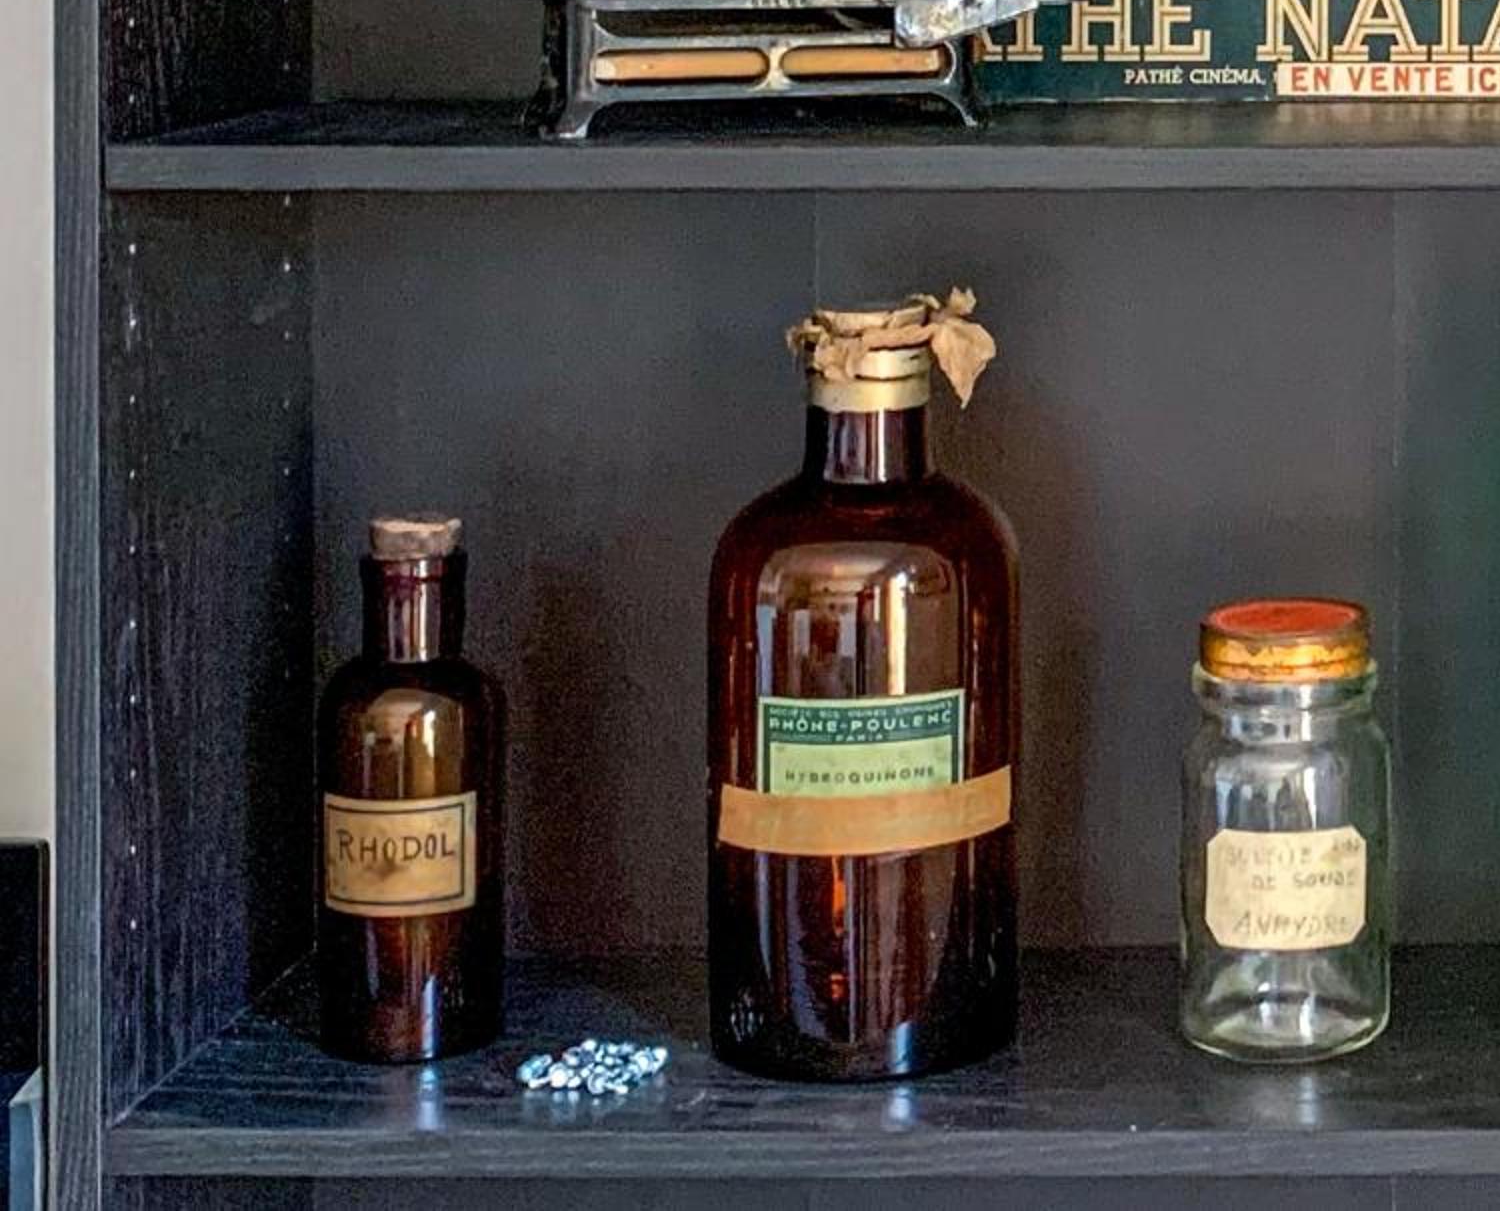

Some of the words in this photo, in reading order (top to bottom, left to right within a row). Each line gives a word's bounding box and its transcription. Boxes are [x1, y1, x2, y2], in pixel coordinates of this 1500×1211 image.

[1124, 65, 1183, 85] PATHÉ
[1291, 66, 1331, 92] EN
[1348, 66, 1453, 93] VENTE
[336, 829, 456, 862] RHODOL
